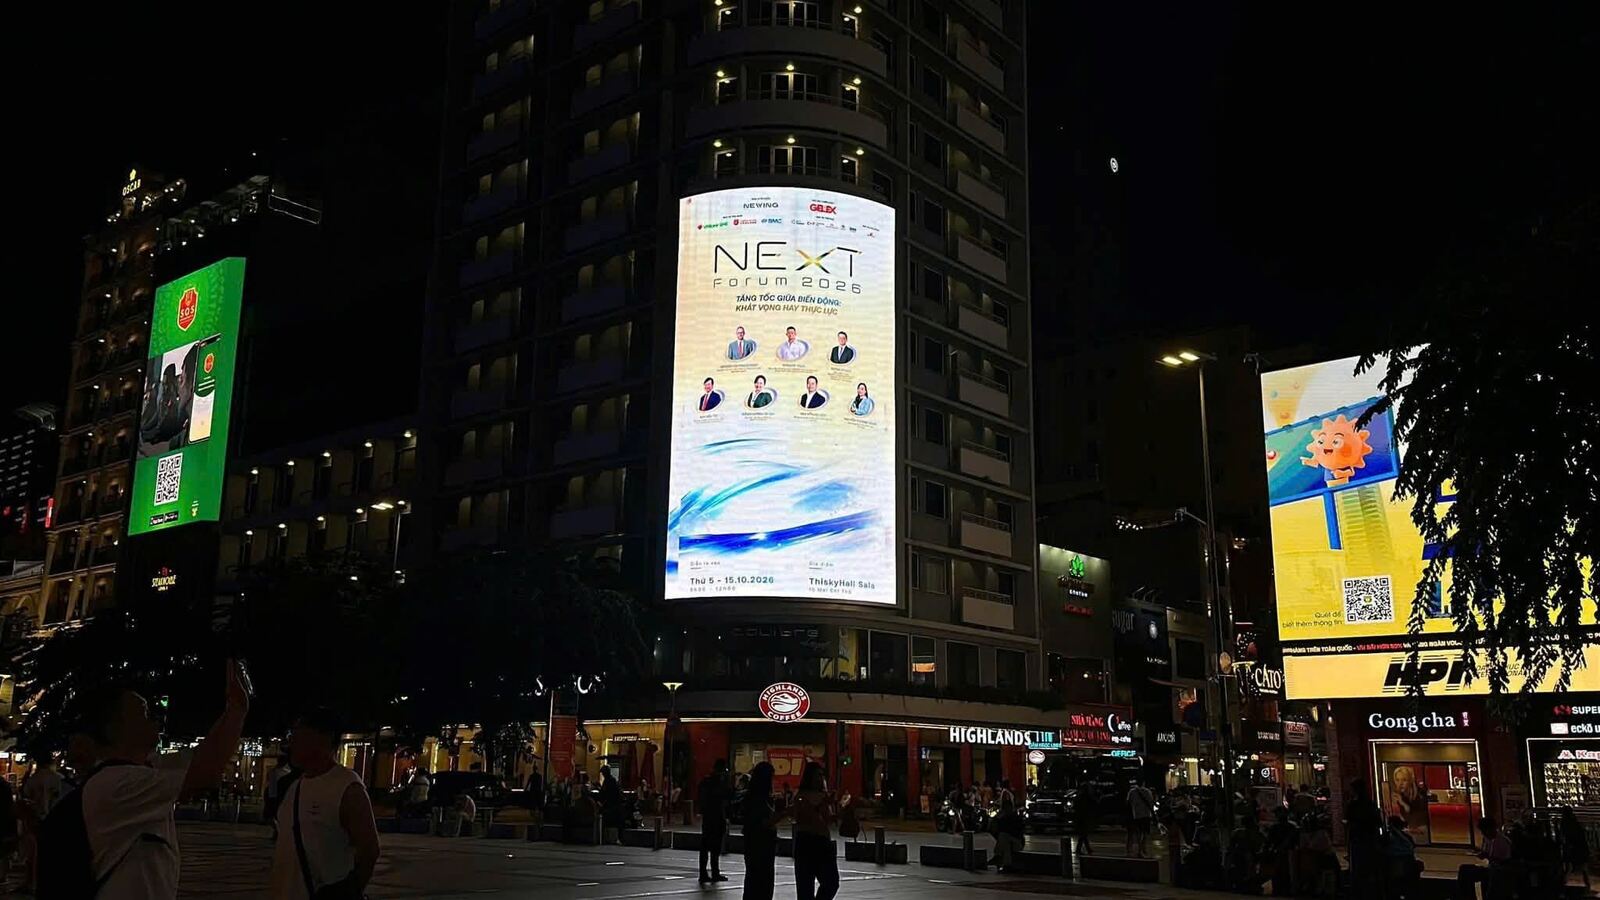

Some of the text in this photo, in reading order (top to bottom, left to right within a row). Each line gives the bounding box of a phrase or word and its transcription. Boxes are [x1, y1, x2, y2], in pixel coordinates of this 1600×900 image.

[810, 203, 837, 215] GELEX
[714, 241, 862, 277] NEXT
[802, 277, 861, 294] 2026
[782, 304, 800, 312] HAY
[725, 576, 774, 584] 15.10.2026
[762, 685, 807, 701] HIGHLANDS
[767, 711, 801, 721] COFFEE
[1368, 712, 1456, 733] Gong cha
[950, 726, 1031, 747] HIGHLANDS
